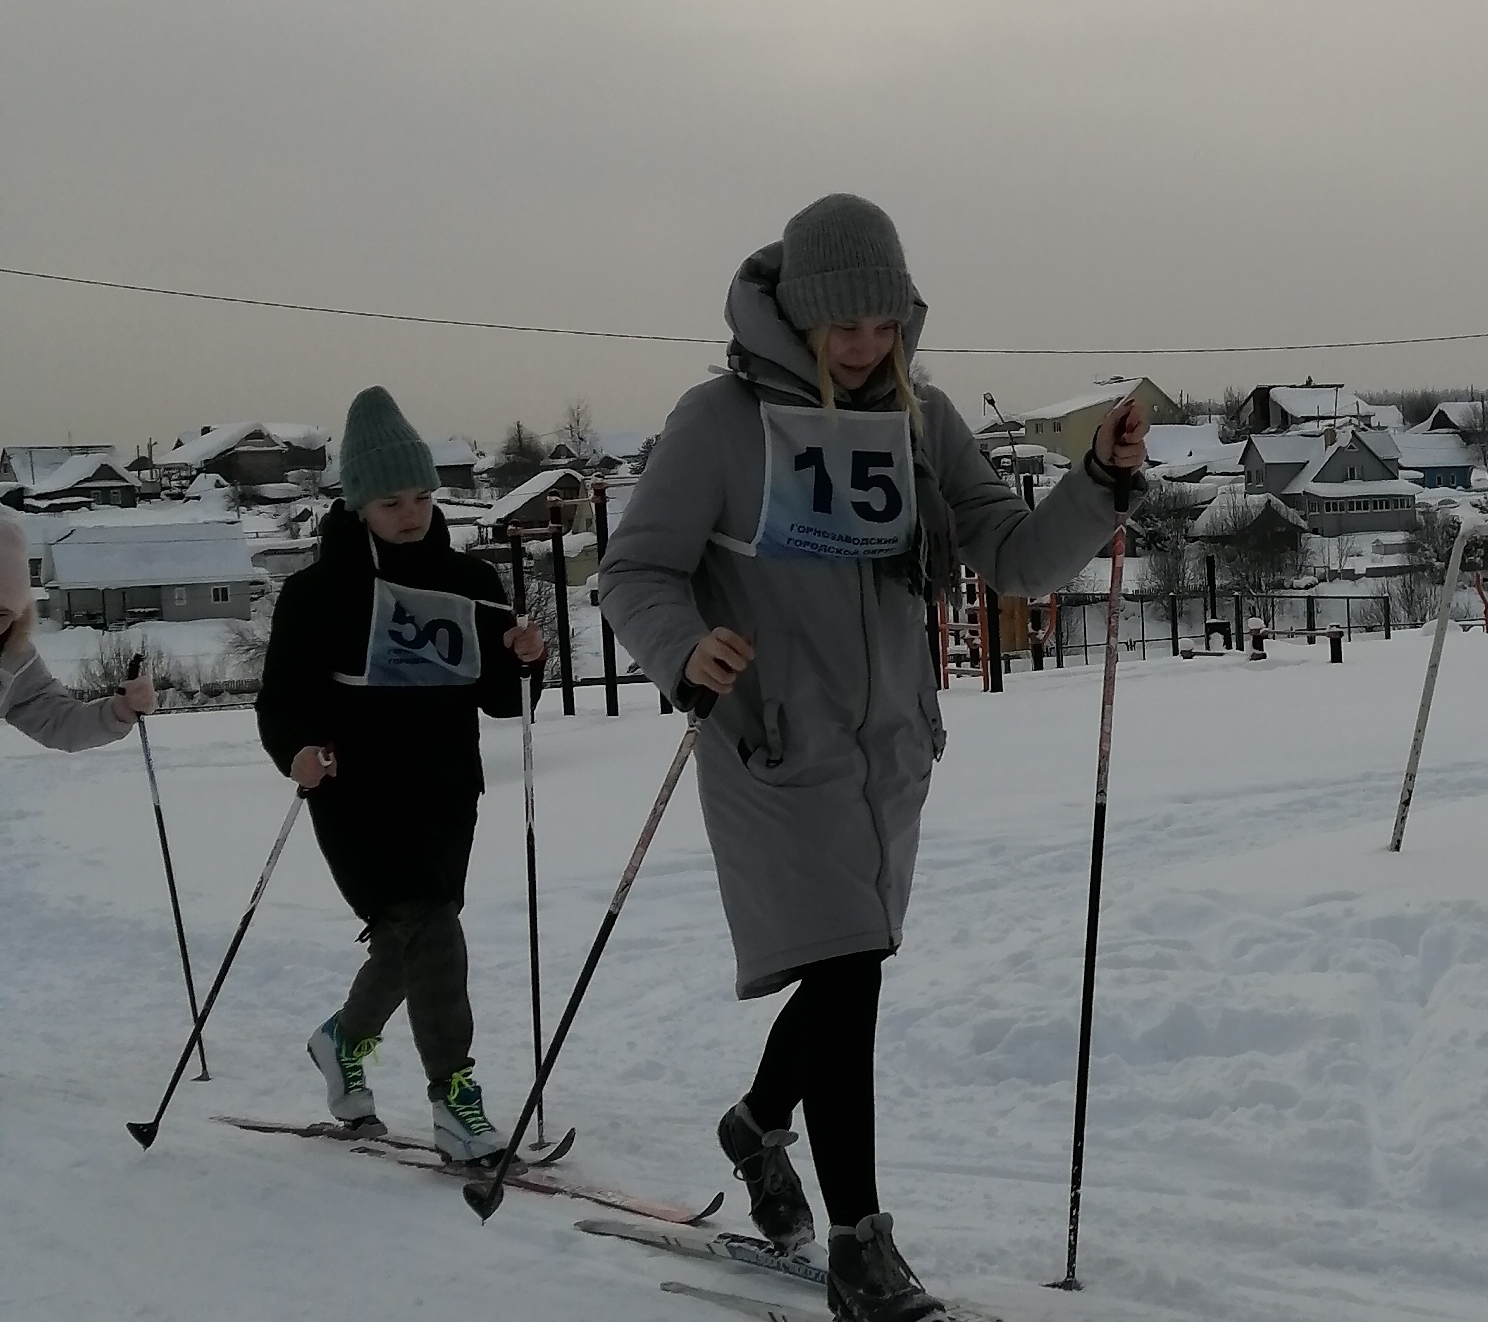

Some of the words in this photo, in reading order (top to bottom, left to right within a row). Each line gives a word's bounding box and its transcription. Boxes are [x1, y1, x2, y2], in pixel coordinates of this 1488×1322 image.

[794, 446, 903, 524] 15
[786, 537, 860, 556] ГОРОДСКОЙ
[790, 523, 899, 546] ГОРНОЗАВОДСКИЙ
[388, 601, 464, 667] 50
